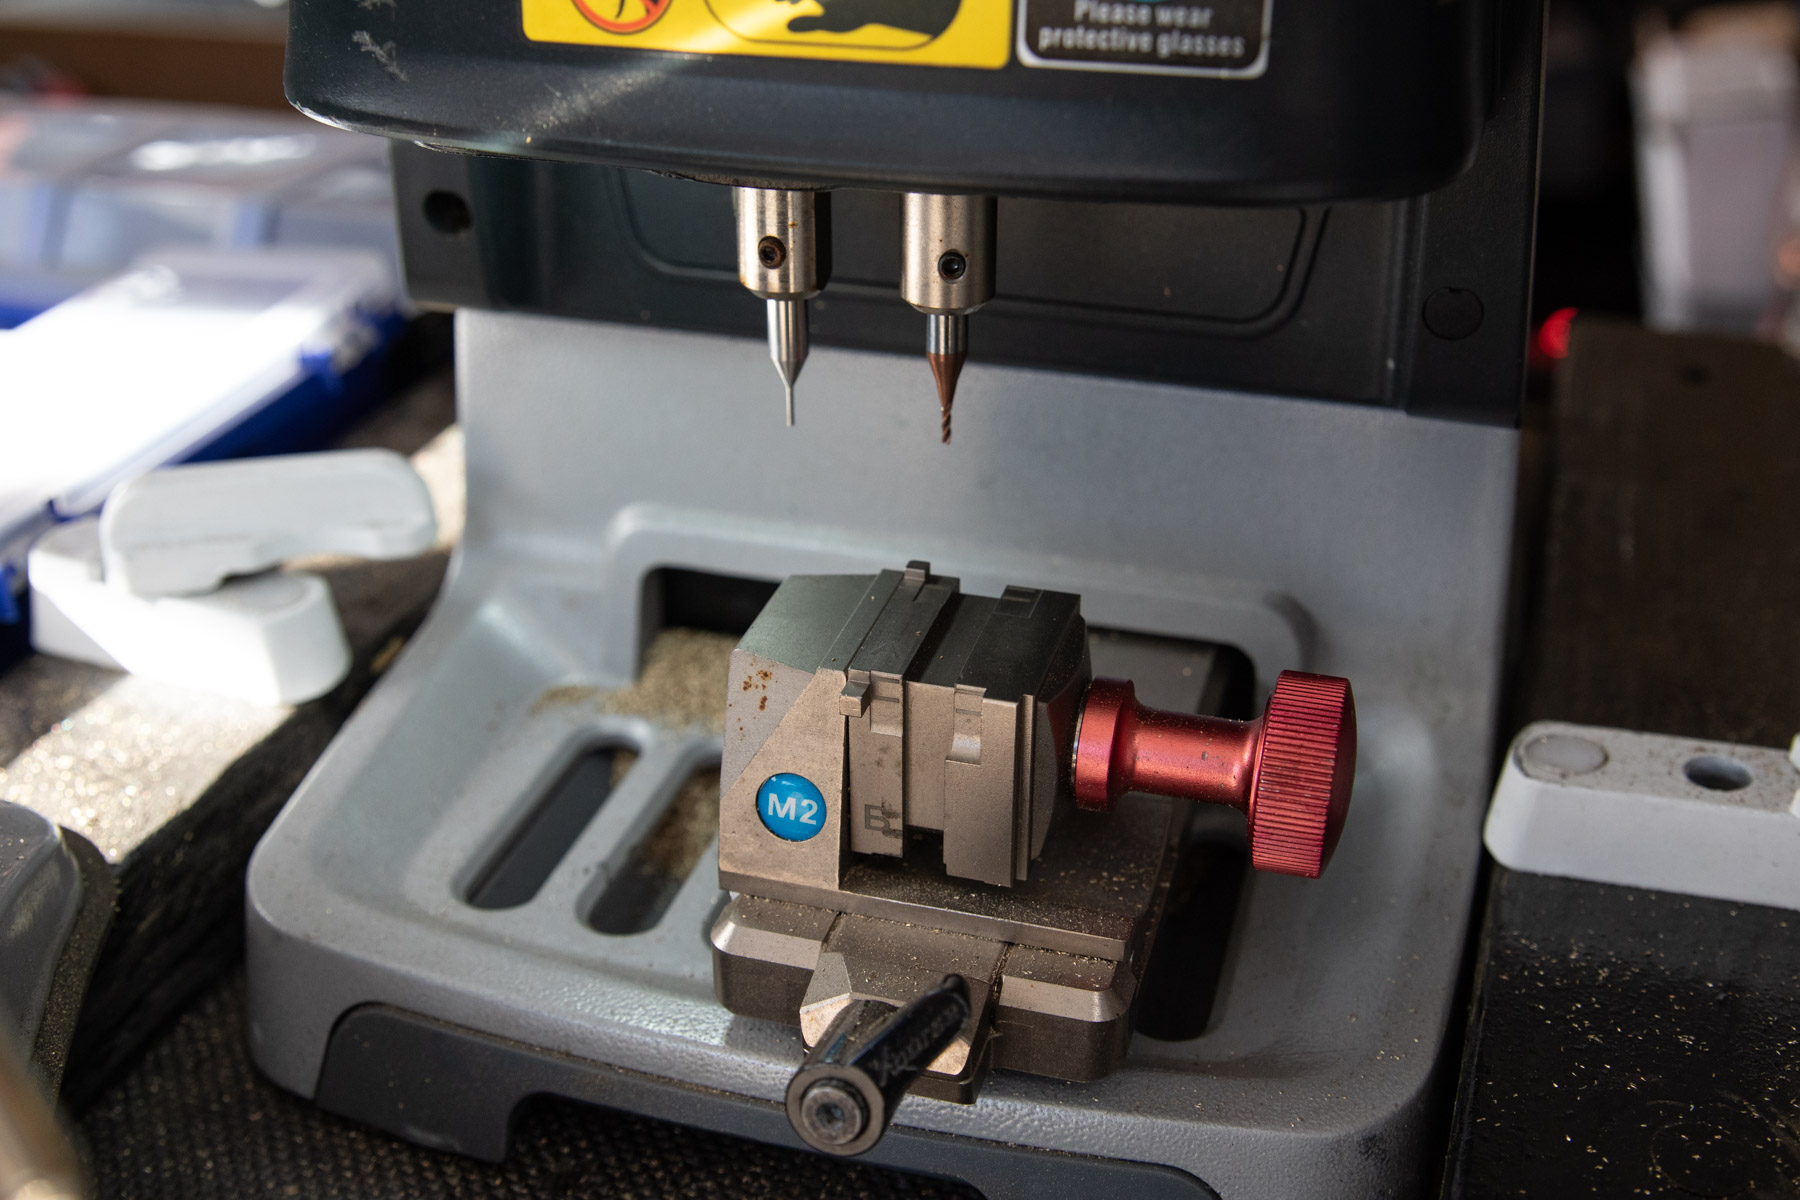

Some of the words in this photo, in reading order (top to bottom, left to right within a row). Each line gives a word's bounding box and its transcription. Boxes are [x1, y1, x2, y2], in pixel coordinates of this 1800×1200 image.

[1074, 0, 1150, 26] Please
[1155, 6, 1213, 28] wear
[1038, 25, 1152, 53] protective
[1156, 29, 1245, 58] glasses
[767, 792, 818, 826] M2
